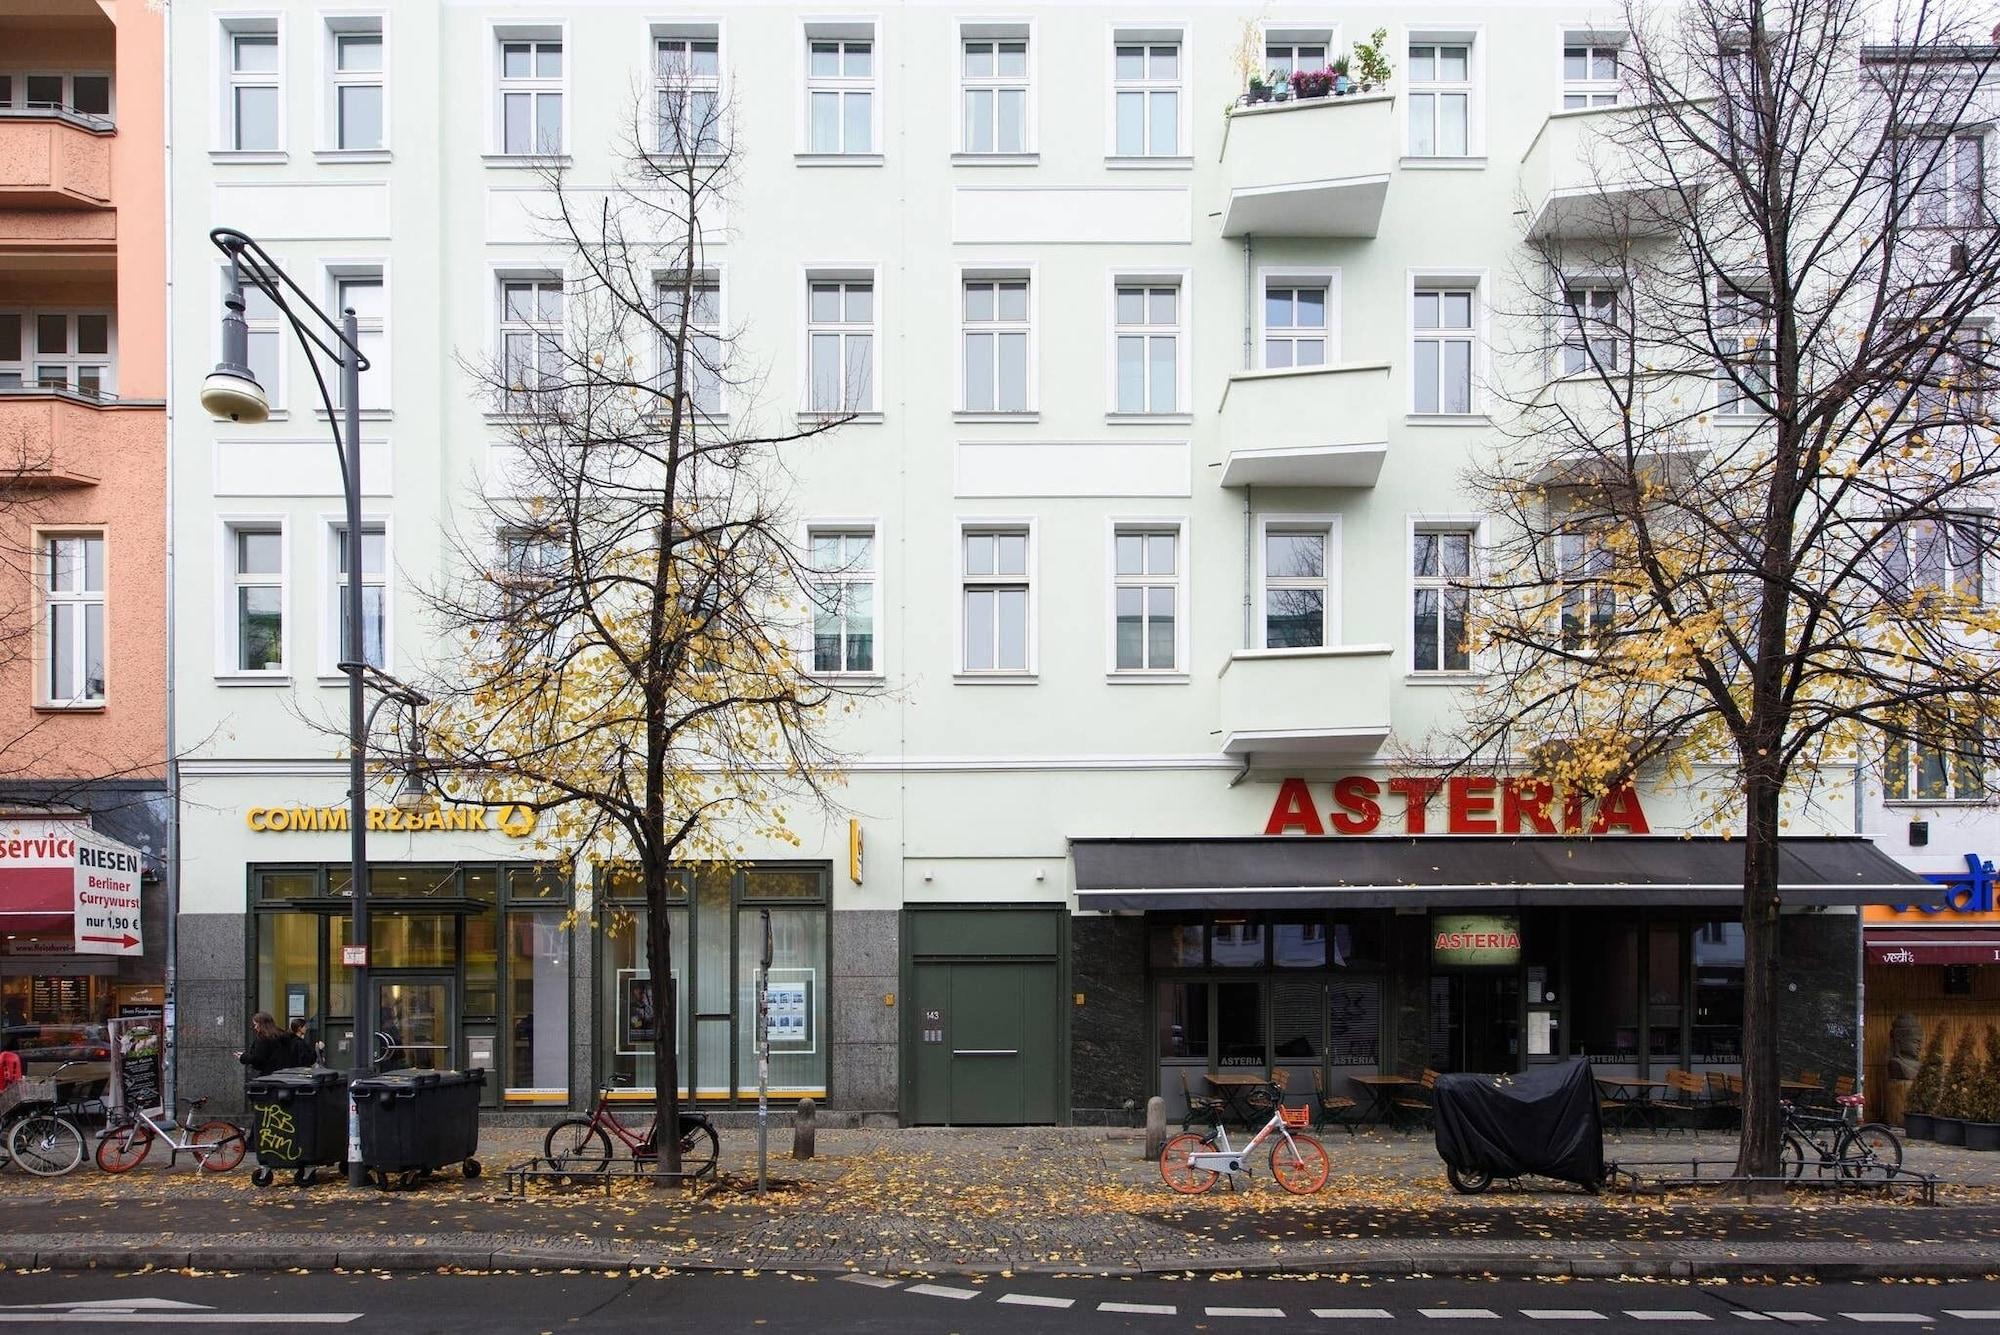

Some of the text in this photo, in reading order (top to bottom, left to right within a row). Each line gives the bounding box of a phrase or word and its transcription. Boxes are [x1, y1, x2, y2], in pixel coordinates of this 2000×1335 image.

[246, 807, 488, 832] COMMRZBANK
[79, 847, 137, 872] RIESEN
[88, 876, 131, 892] Berliner
[79, 891, 141, 909] Currywurst
[86, 916, 140, 930] nur 1,90 €
[1435, 932, 1521, 949] ASTERIA
[926, 1011, 940, 1020] 143
[1220, 1056, 1263, 1066] ASTERIA
[1333, 1056, 1376, 1065] ASTERIA
[1588, 1055, 1625, 1064] STERIA
[1704, 1054, 1742, 1064] ASTERI
